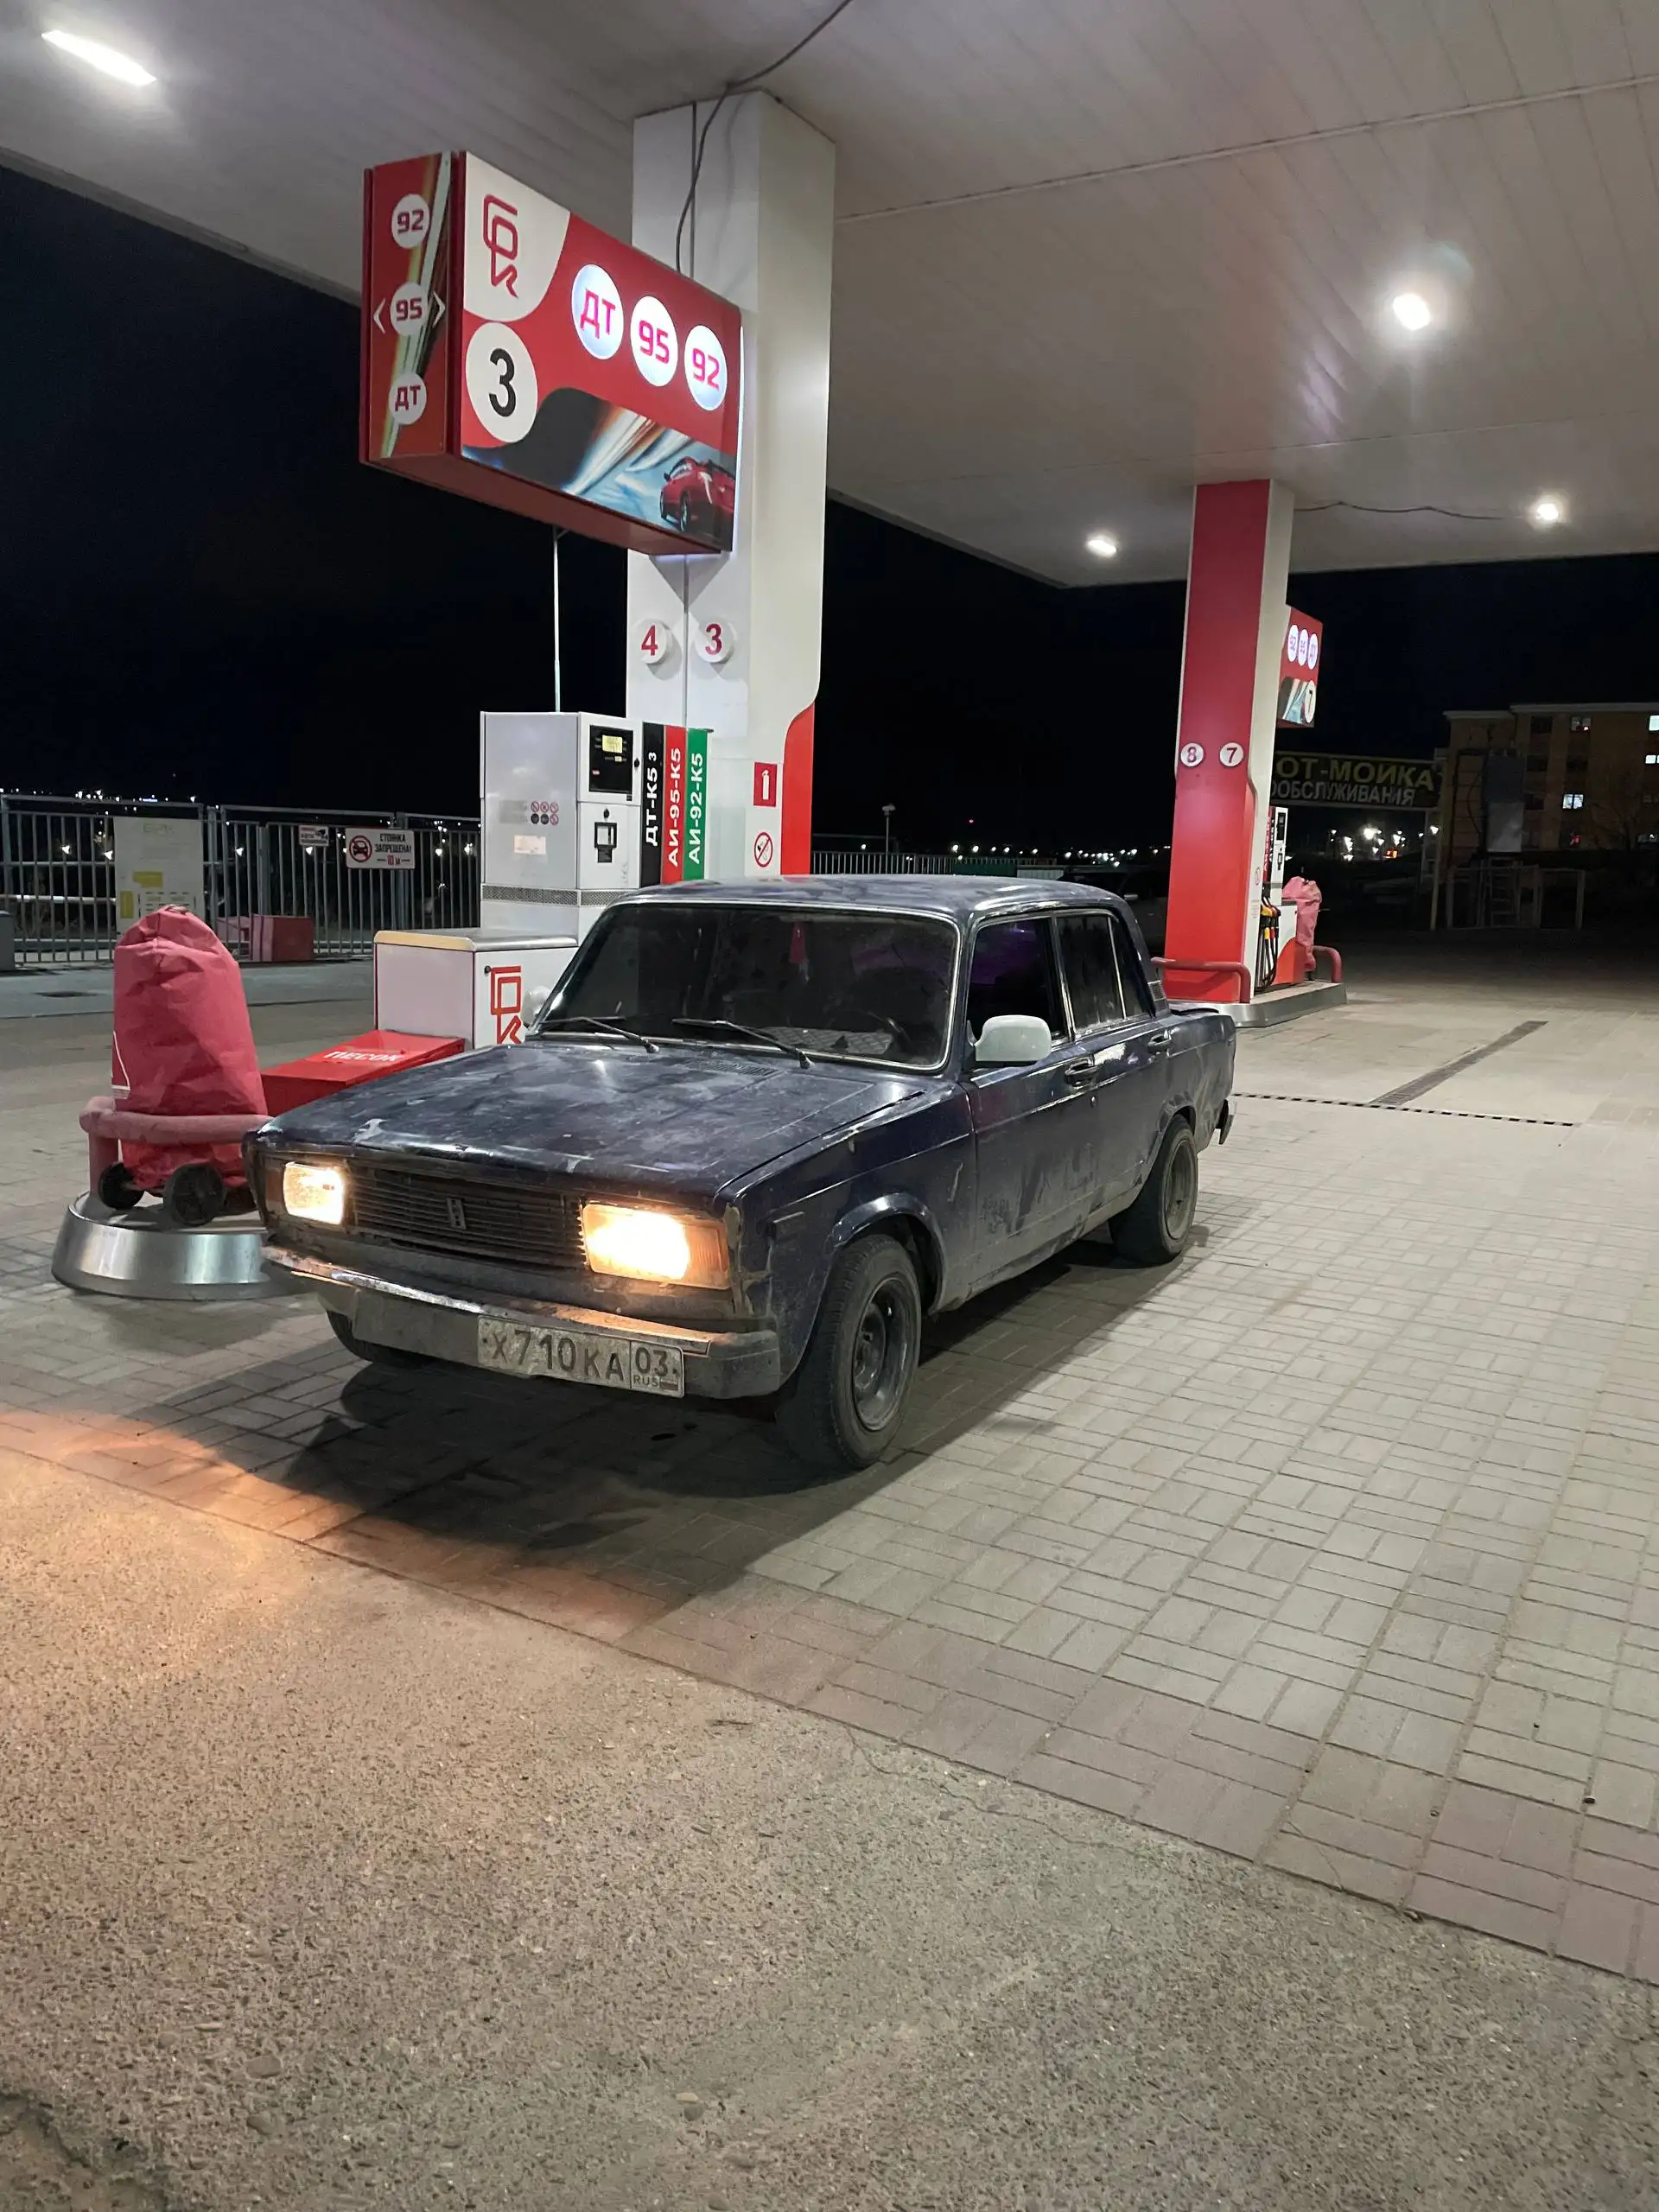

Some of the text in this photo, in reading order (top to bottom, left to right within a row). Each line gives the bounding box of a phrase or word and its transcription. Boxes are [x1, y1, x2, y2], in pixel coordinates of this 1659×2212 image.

[397, 209, 424, 233] 92
[396, 298, 423, 321] 95
[581, 289, 720, 391] ДТ 95 92
[488, 347, 517, 417] 3
[394, 385, 422, 411] ДТ
[641, 625, 658, 656] 4
[705, 623, 722, 655] 3
[1187, 747, 1197, 762] 8
[1227, 747, 1237, 763] 7
[646, 767, 658, 847] ДТ-К5
[668, 747, 681, 868] АИ-95-К5
[689, 753, 703, 865] АИ-92-К5
[323, 1051, 405, 1062] ПЕСОК
[635, 1346, 668, 1376] 03
[633, 1374, 659, 1388] RUS
